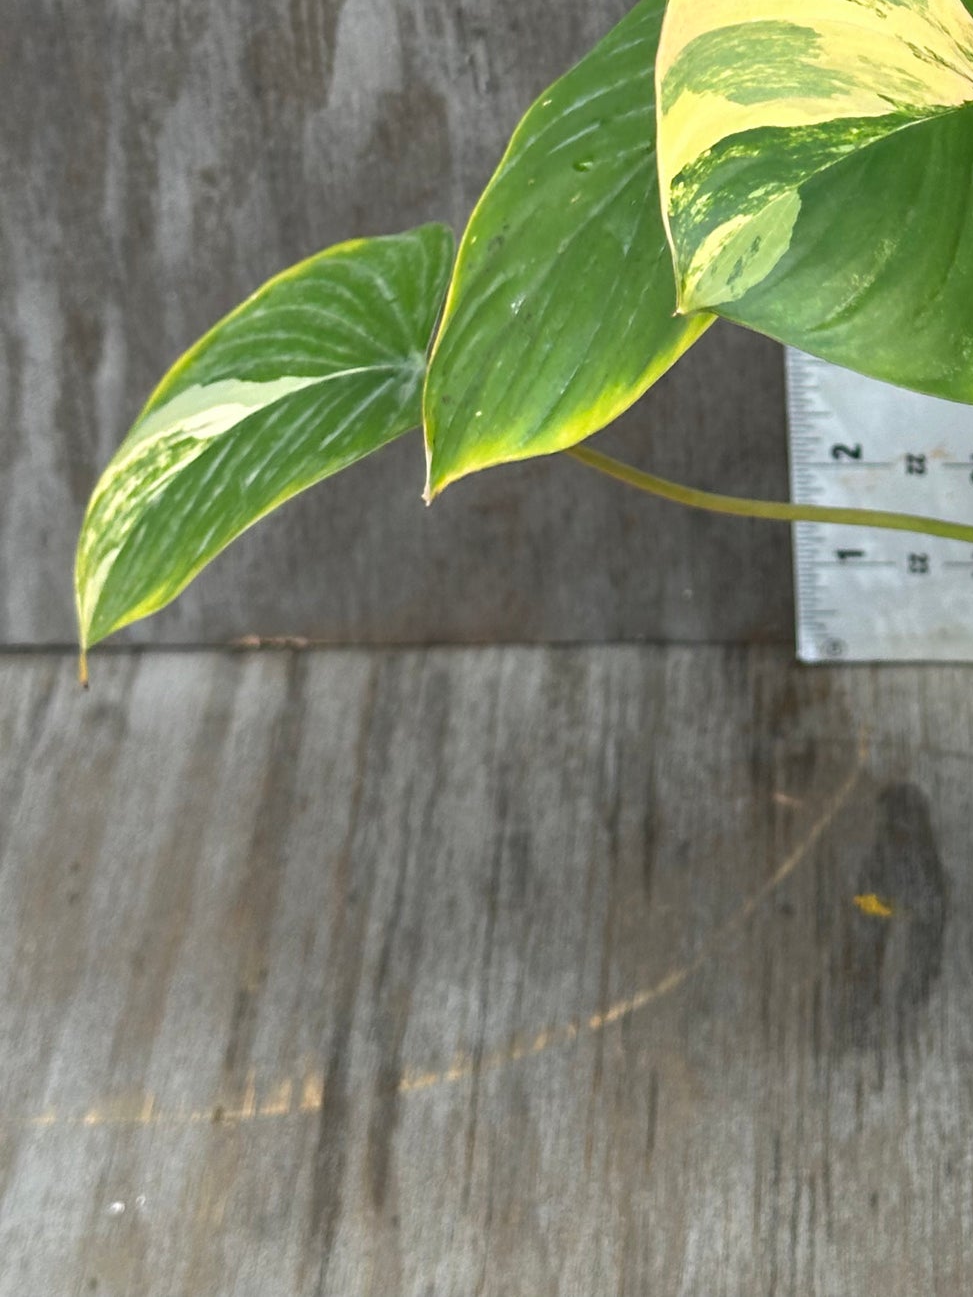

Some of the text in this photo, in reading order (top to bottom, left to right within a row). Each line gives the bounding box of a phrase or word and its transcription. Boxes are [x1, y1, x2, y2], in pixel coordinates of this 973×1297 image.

[831, 443, 862, 460] 2
[905, 452, 927, 475] 22
[836, 549, 865, 564] 1
